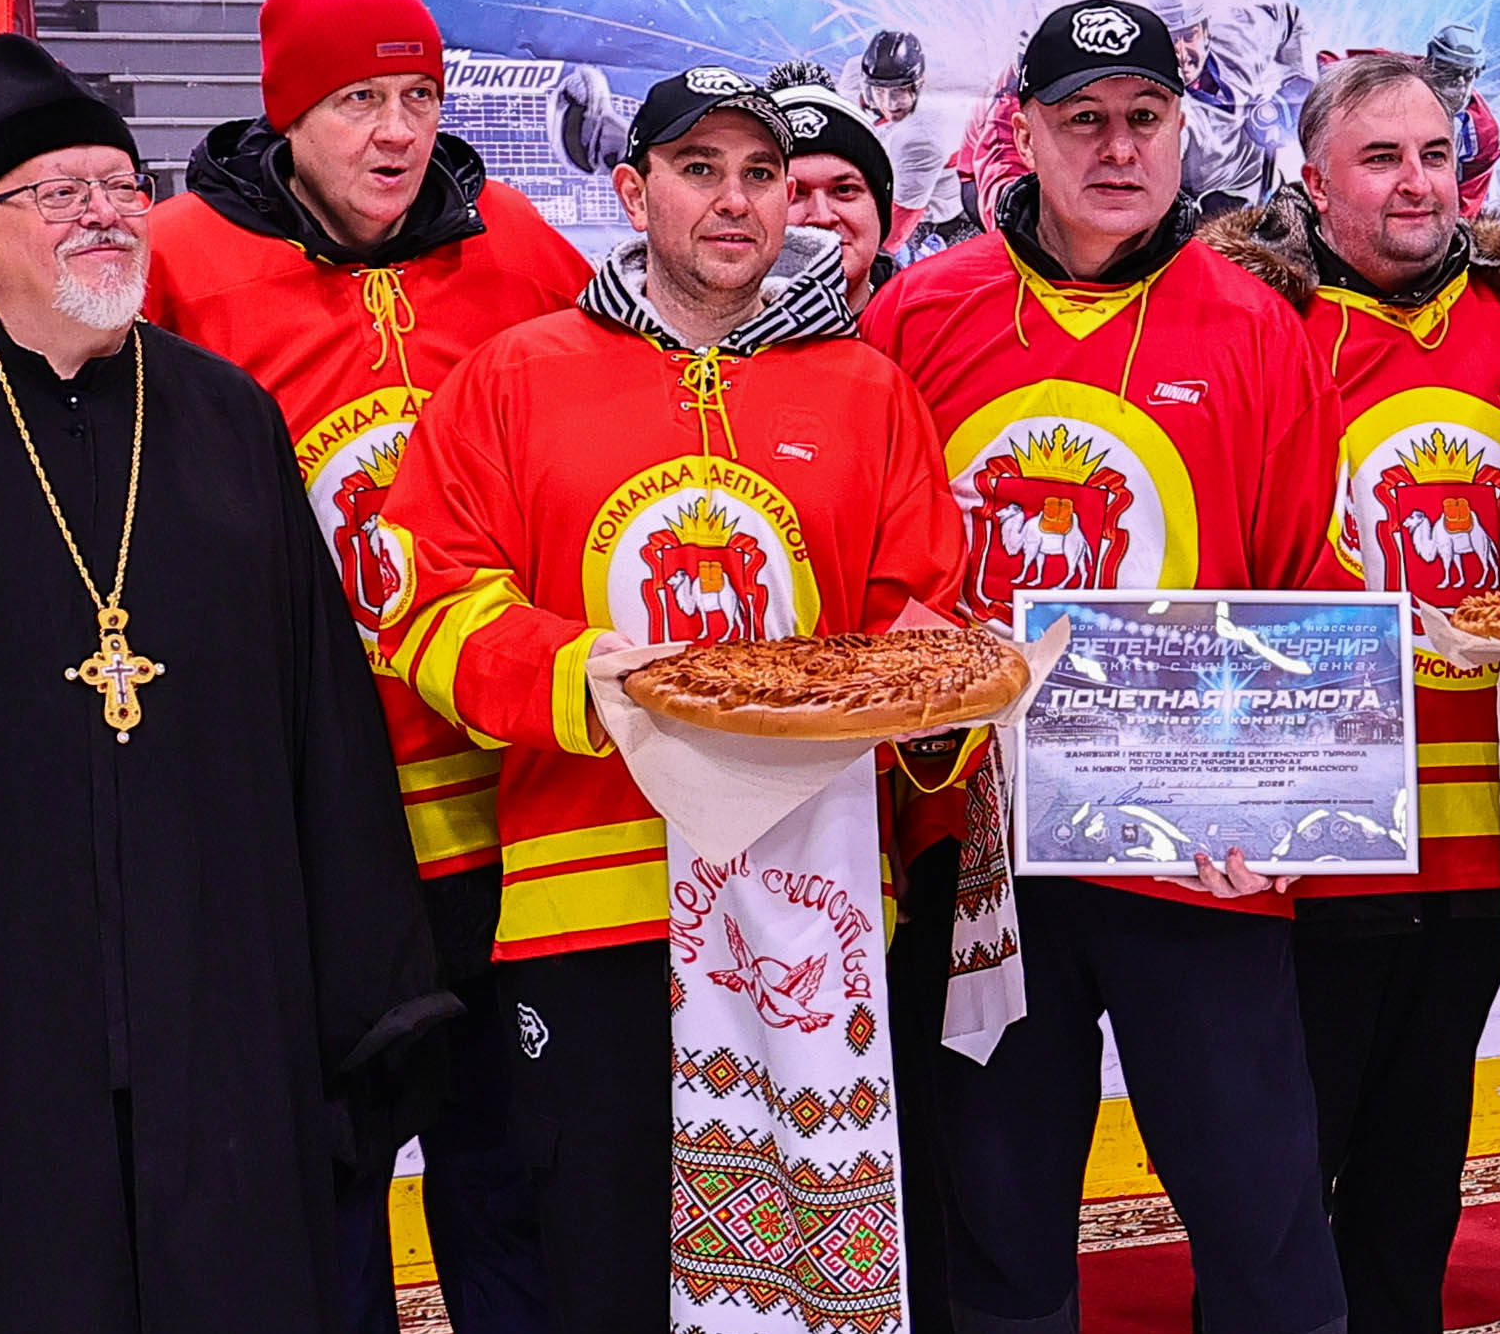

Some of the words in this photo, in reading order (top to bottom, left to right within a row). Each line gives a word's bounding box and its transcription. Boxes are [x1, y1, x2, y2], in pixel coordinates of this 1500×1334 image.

[1152, 380, 1202, 406] TUNIKA
[300, 399, 389, 483] МАНДА
[591, 463, 694, 555] КОМАНДА
[704, 463, 810, 563] ДЕПУТАТОВ
[1050, 689, 1224, 710] ПОЧЕТНАЯ
[1232, 688, 1382, 710] ГРАМОТА
[762, 869, 872, 999] счастья
